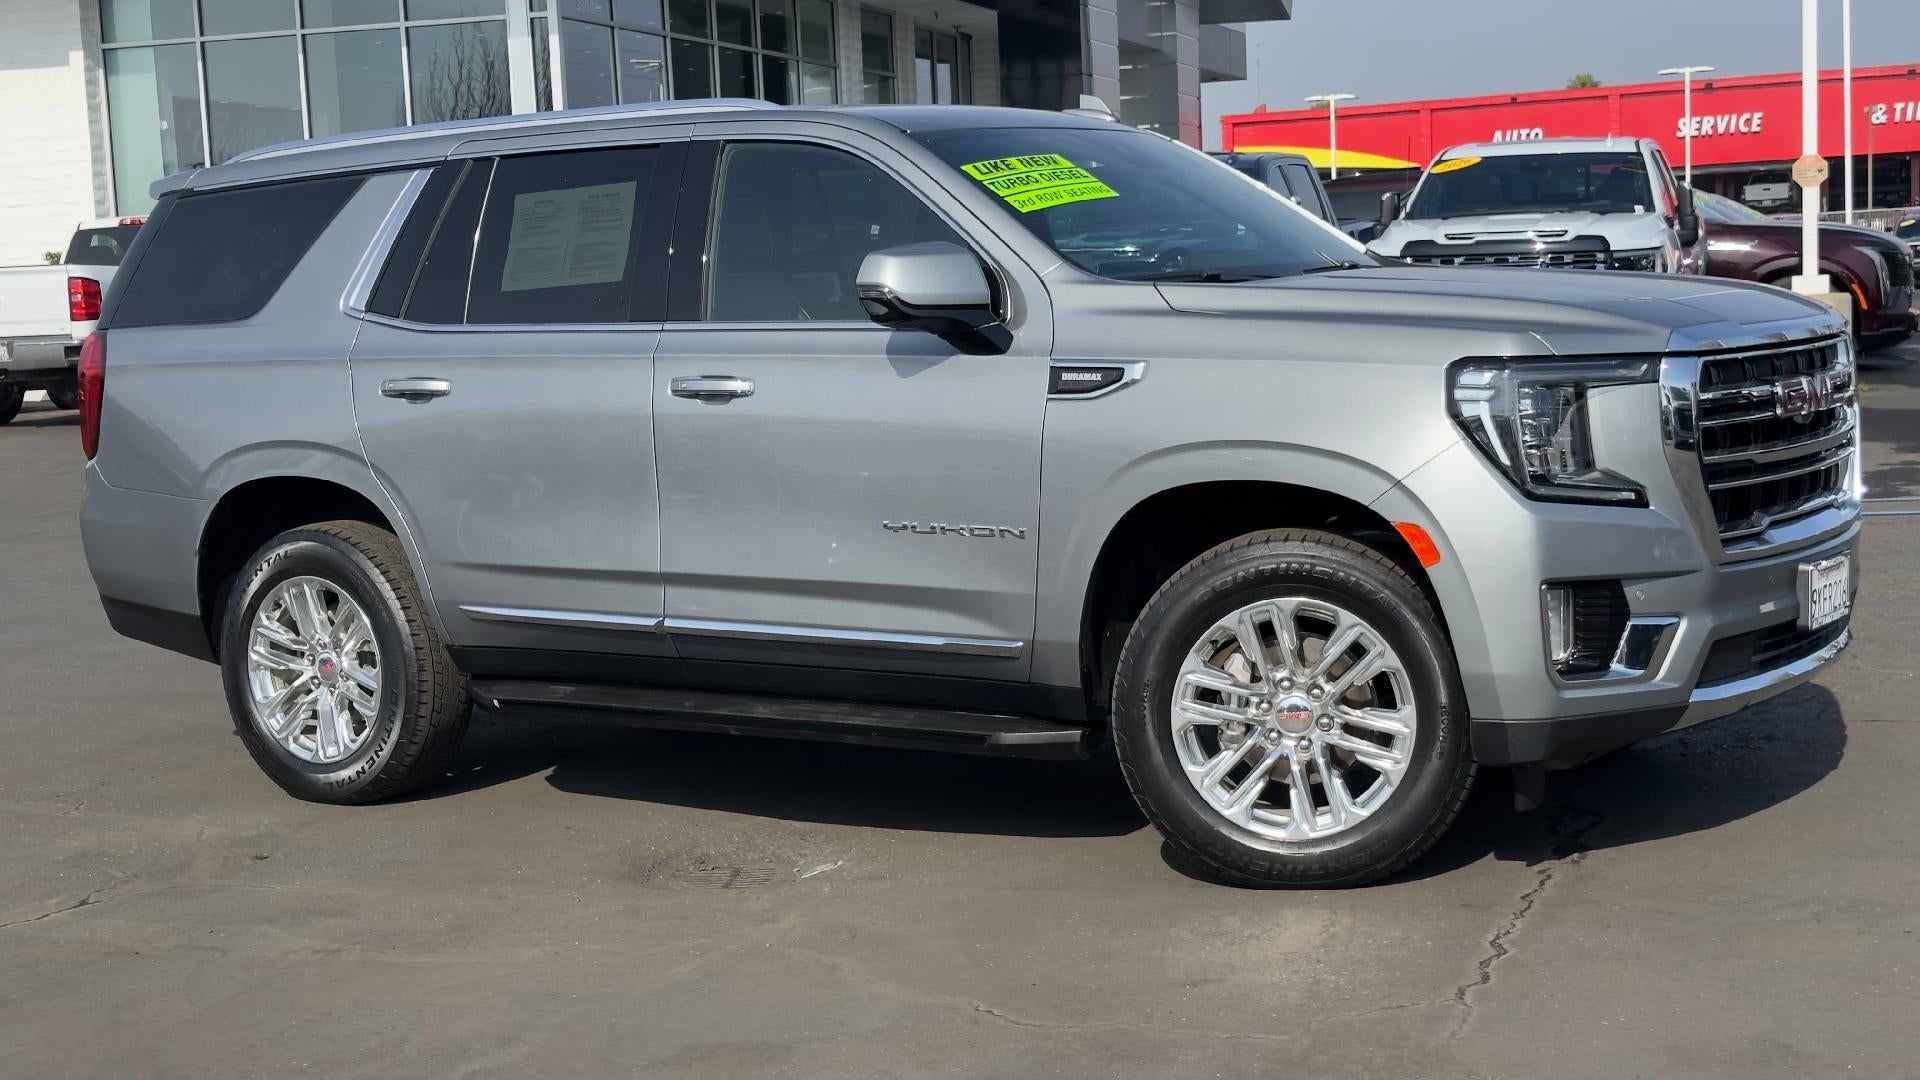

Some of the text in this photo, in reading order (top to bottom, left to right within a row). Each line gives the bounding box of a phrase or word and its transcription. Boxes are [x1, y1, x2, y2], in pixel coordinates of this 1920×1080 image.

[1492, 127, 1544, 143] AUTO
[1676, 111, 1763, 138] SERVICE
[1871, 103, 1889, 125] &
[972, 155, 1059, 176] LIKE NEW
[987, 168, 1089, 191] TURBO DIESEL
[1013, 184, 1110, 209] 3rd ROW SEATING
[1061, 372, 1102, 381] DURAMAX
[1775, 368, 1853, 416] GMC
[882, 520, 1026, 540] YUKON
